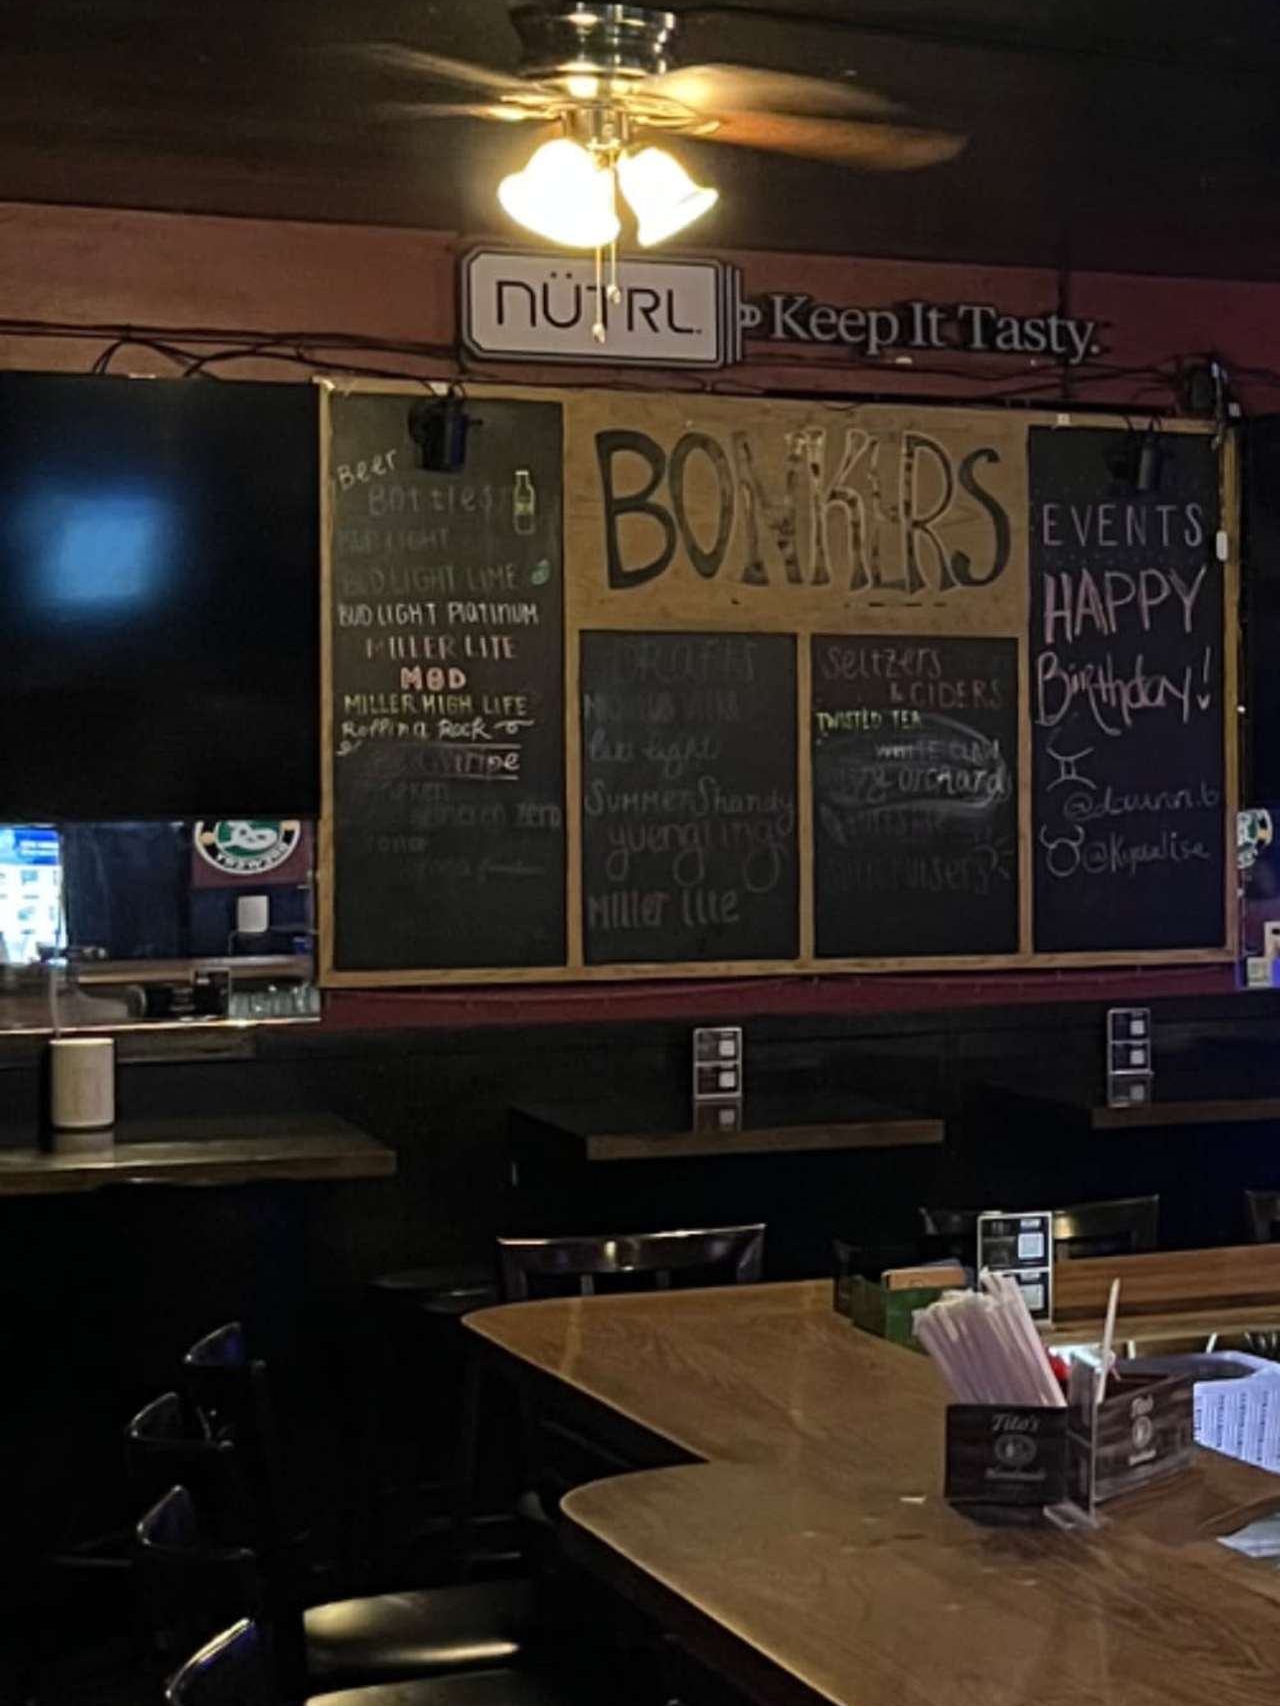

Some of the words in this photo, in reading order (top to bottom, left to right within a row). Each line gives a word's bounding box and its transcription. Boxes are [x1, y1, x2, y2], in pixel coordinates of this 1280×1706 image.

[768, 293, 899, 356] Keep
[908, 300, 947, 335] It
[337, 449, 397, 491] Beer
[595, 427, 1010, 595] BONKERS
[1042, 501, 1203, 548] EVENTS
[337, 602, 373, 627] BUD
[377, 602, 438, 627] LIGHT
[1043, 564, 1208, 646] HAPPY
[365, 635, 457, 661] MILLER
[464, 636, 520, 661] LITE
[343, 693, 421, 714] MILLER
[421, 693, 473, 715] HIGH
[482, 695, 528, 716] LIFE
[909, 677, 1002, 709] CIDERS
[990, 1413, 1042, 1432] Tito's
